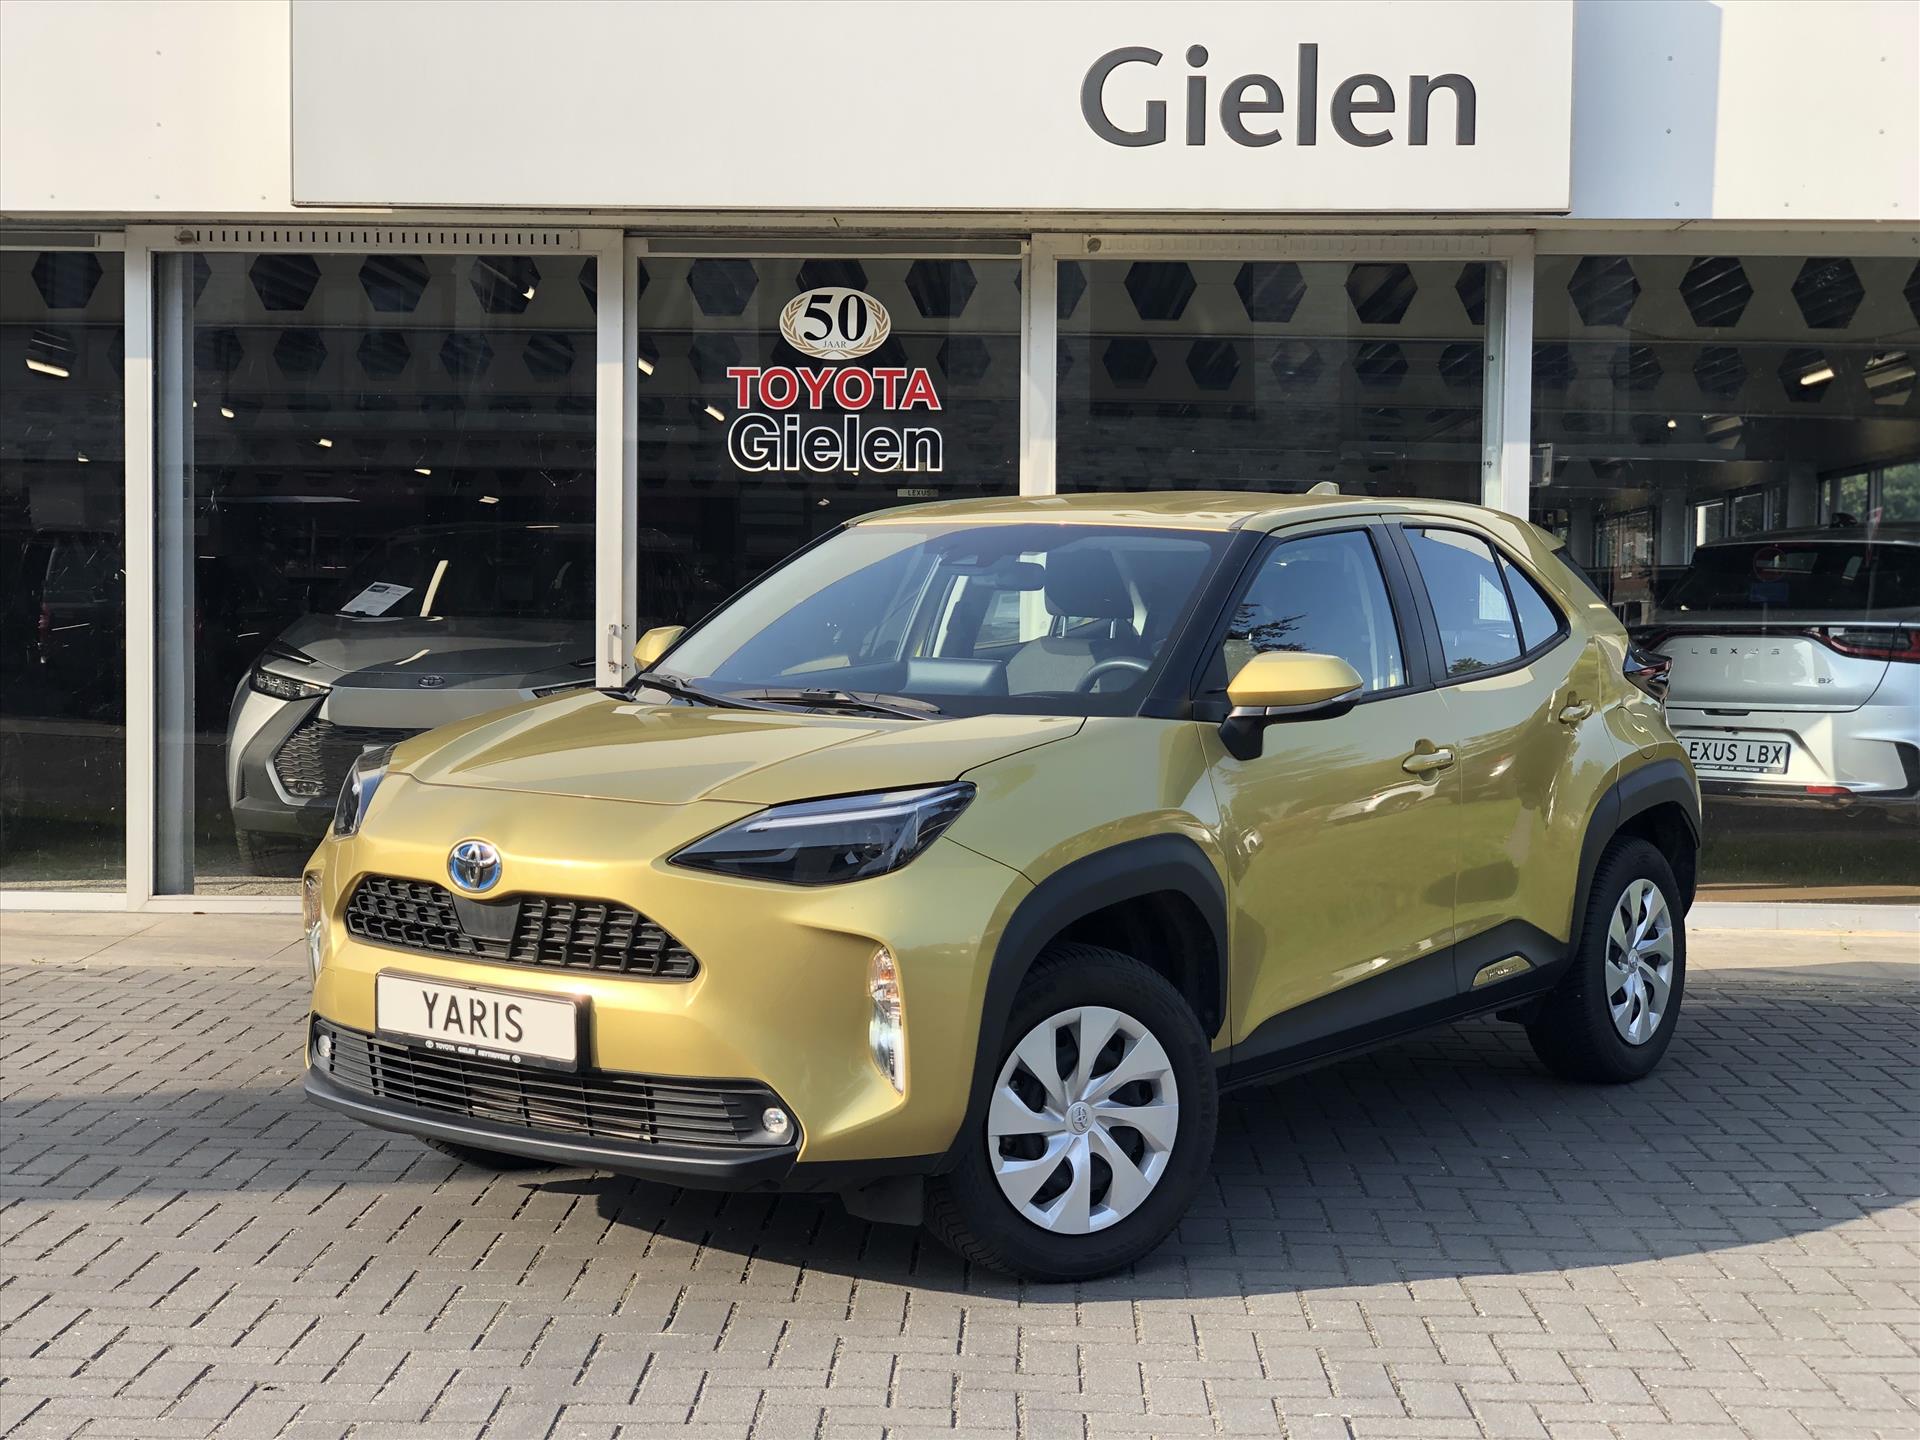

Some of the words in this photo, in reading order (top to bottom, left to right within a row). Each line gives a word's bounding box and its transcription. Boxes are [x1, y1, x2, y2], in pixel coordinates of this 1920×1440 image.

[1080, 43, 1476, 147] Gielen
[804, 294, 868, 341] 50
[727, 366, 942, 411] TOYOTA
[728, 413, 943, 472] Gielen
[1690, 647, 1780, 655] LEXUS
[1681, 741, 1738, 762] EXUS
[1746, 744, 1783, 764] LBX
[422, 990, 523, 1043] YARIS
[435, 1042, 456, 1052] TOYOTA
